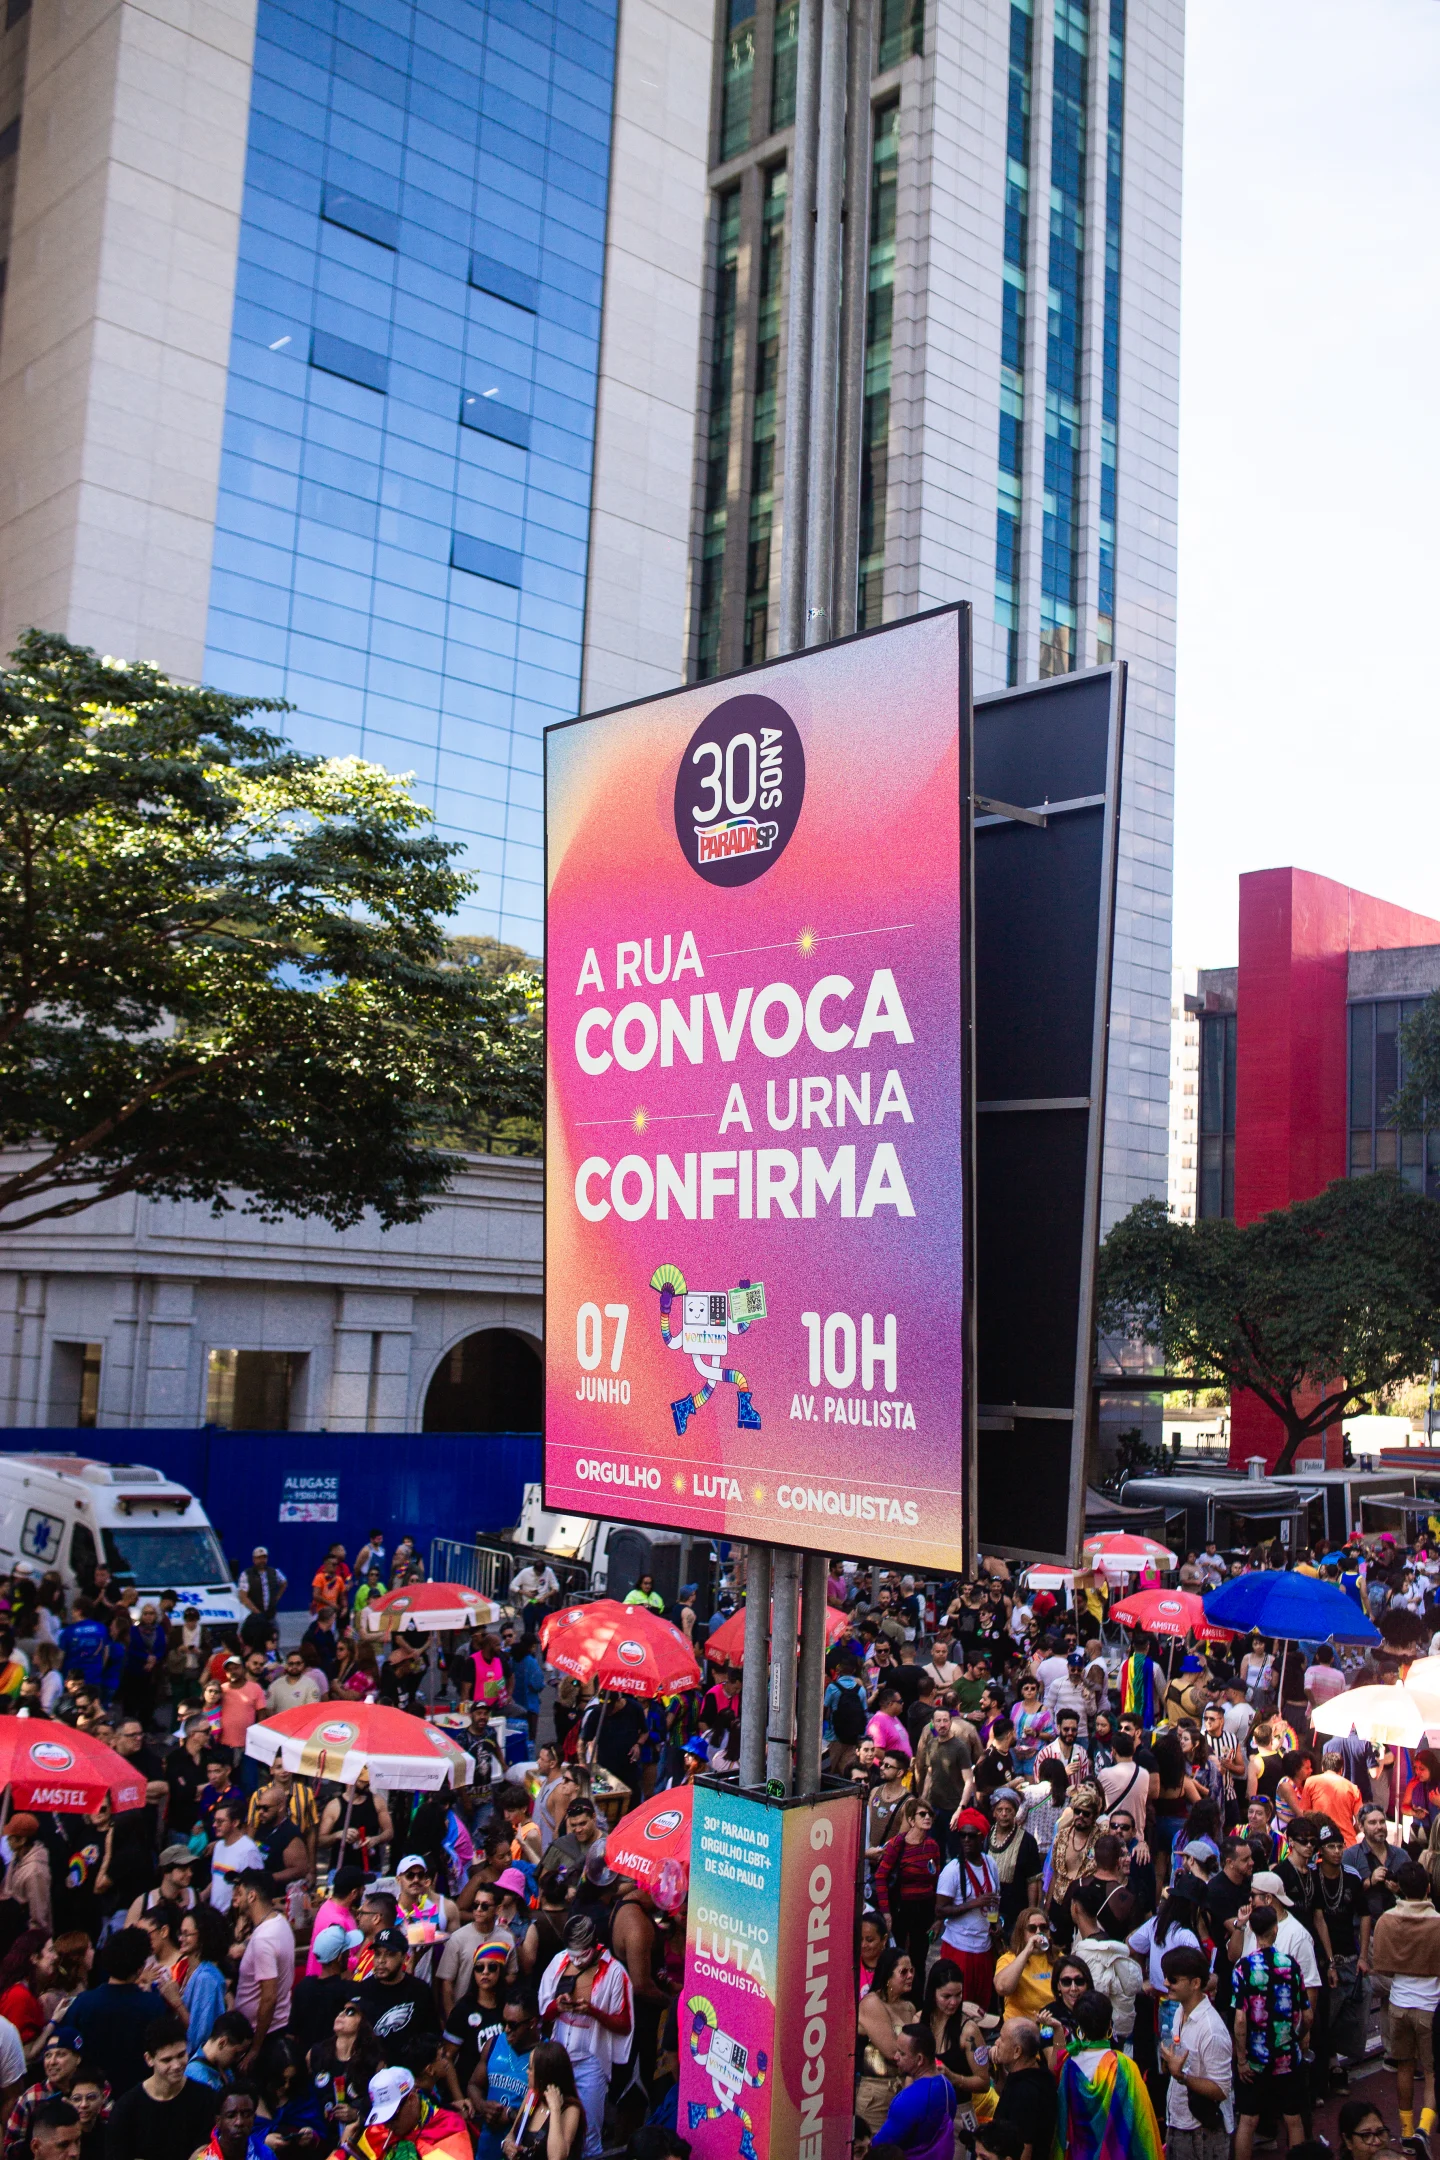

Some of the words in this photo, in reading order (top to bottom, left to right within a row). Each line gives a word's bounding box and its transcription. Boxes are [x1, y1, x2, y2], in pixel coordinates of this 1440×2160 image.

[692, 732, 757, 823] 30
[759, 727, 783, 811] ANOS
[576, 947, 604, 996] A
[616, 931, 705, 990] RUA
[575, 967, 915, 1076] CONVOCA
[718, 1082, 753, 1134] A
[766, 1069, 915, 1132] URNA
[575, 1142, 917, 1222] CONFIRMA
[576, 1301, 630, 1373] 07
[685, 1330, 727, 1344] VOTINHO
[801, 1311, 897, 1393] 10H
[576, 1376, 631, 1405] JUNHO
[789, 1394, 819, 1422] AV.
[824, 1397, 917, 1431] PAULISTA
[576, 1458, 662, 1490] ORGULHO
[693, 1473, 743, 1502] LUTA
[776, 1485, 920, 1526] CONQUISTAS
[1150, 1621, 1180, 1632] AMSTEL
[1201, 1628, 1226, 1638] AMSTEL
[555, 1653, 585, 1676] AMSTEL
[669, 1675, 694, 1690] AMSTEL
[30, 1788, 88, 1806] AMSTEL
[700, 1836, 743, 1861] ORGULHO
[743, 1849, 772, 1870] LGBT+
[721, 1820, 756, 1845] PARADA
[756, 1831, 770, 1849] DO
[809, 1817, 834, 1851] 9
[614, 1849, 652, 1875] AMSTEL
[704, 1857, 717, 1874] DE
[717, 1859, 736, 1880] SÃO
[736, 1867, 765, 1890] PAULO
[696, 1906, 769, 1945] ORGULHO
[695, 1926, 767, 1982] LUTA
[693, 1960, 767, 1999] CONQUISTAS
[799, 1864, 832, 2160] ENCONTRO
